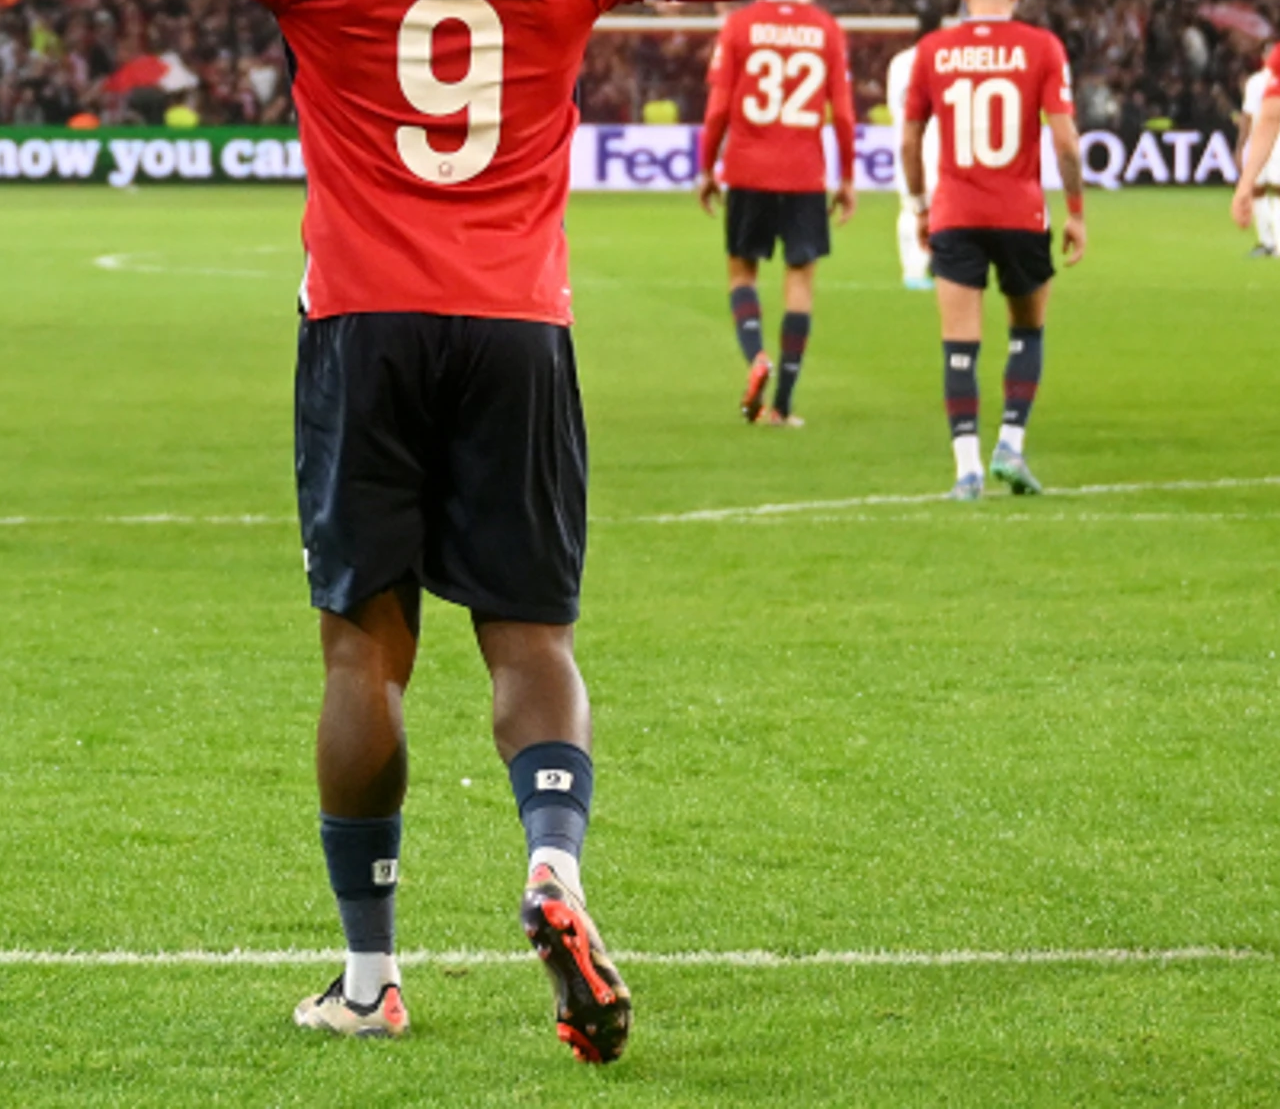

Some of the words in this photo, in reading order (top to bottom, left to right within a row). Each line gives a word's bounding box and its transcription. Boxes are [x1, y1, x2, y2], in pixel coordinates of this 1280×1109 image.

[742, 49, 826, 127] 32
[934, 45, 1027, 74] CABELLA
[943, 77, 1022, 169] 10
[108, 138, 212, 187] you
[595, 127, 699, 184] Fed
[1078, 129, 1244, 190] QATA
